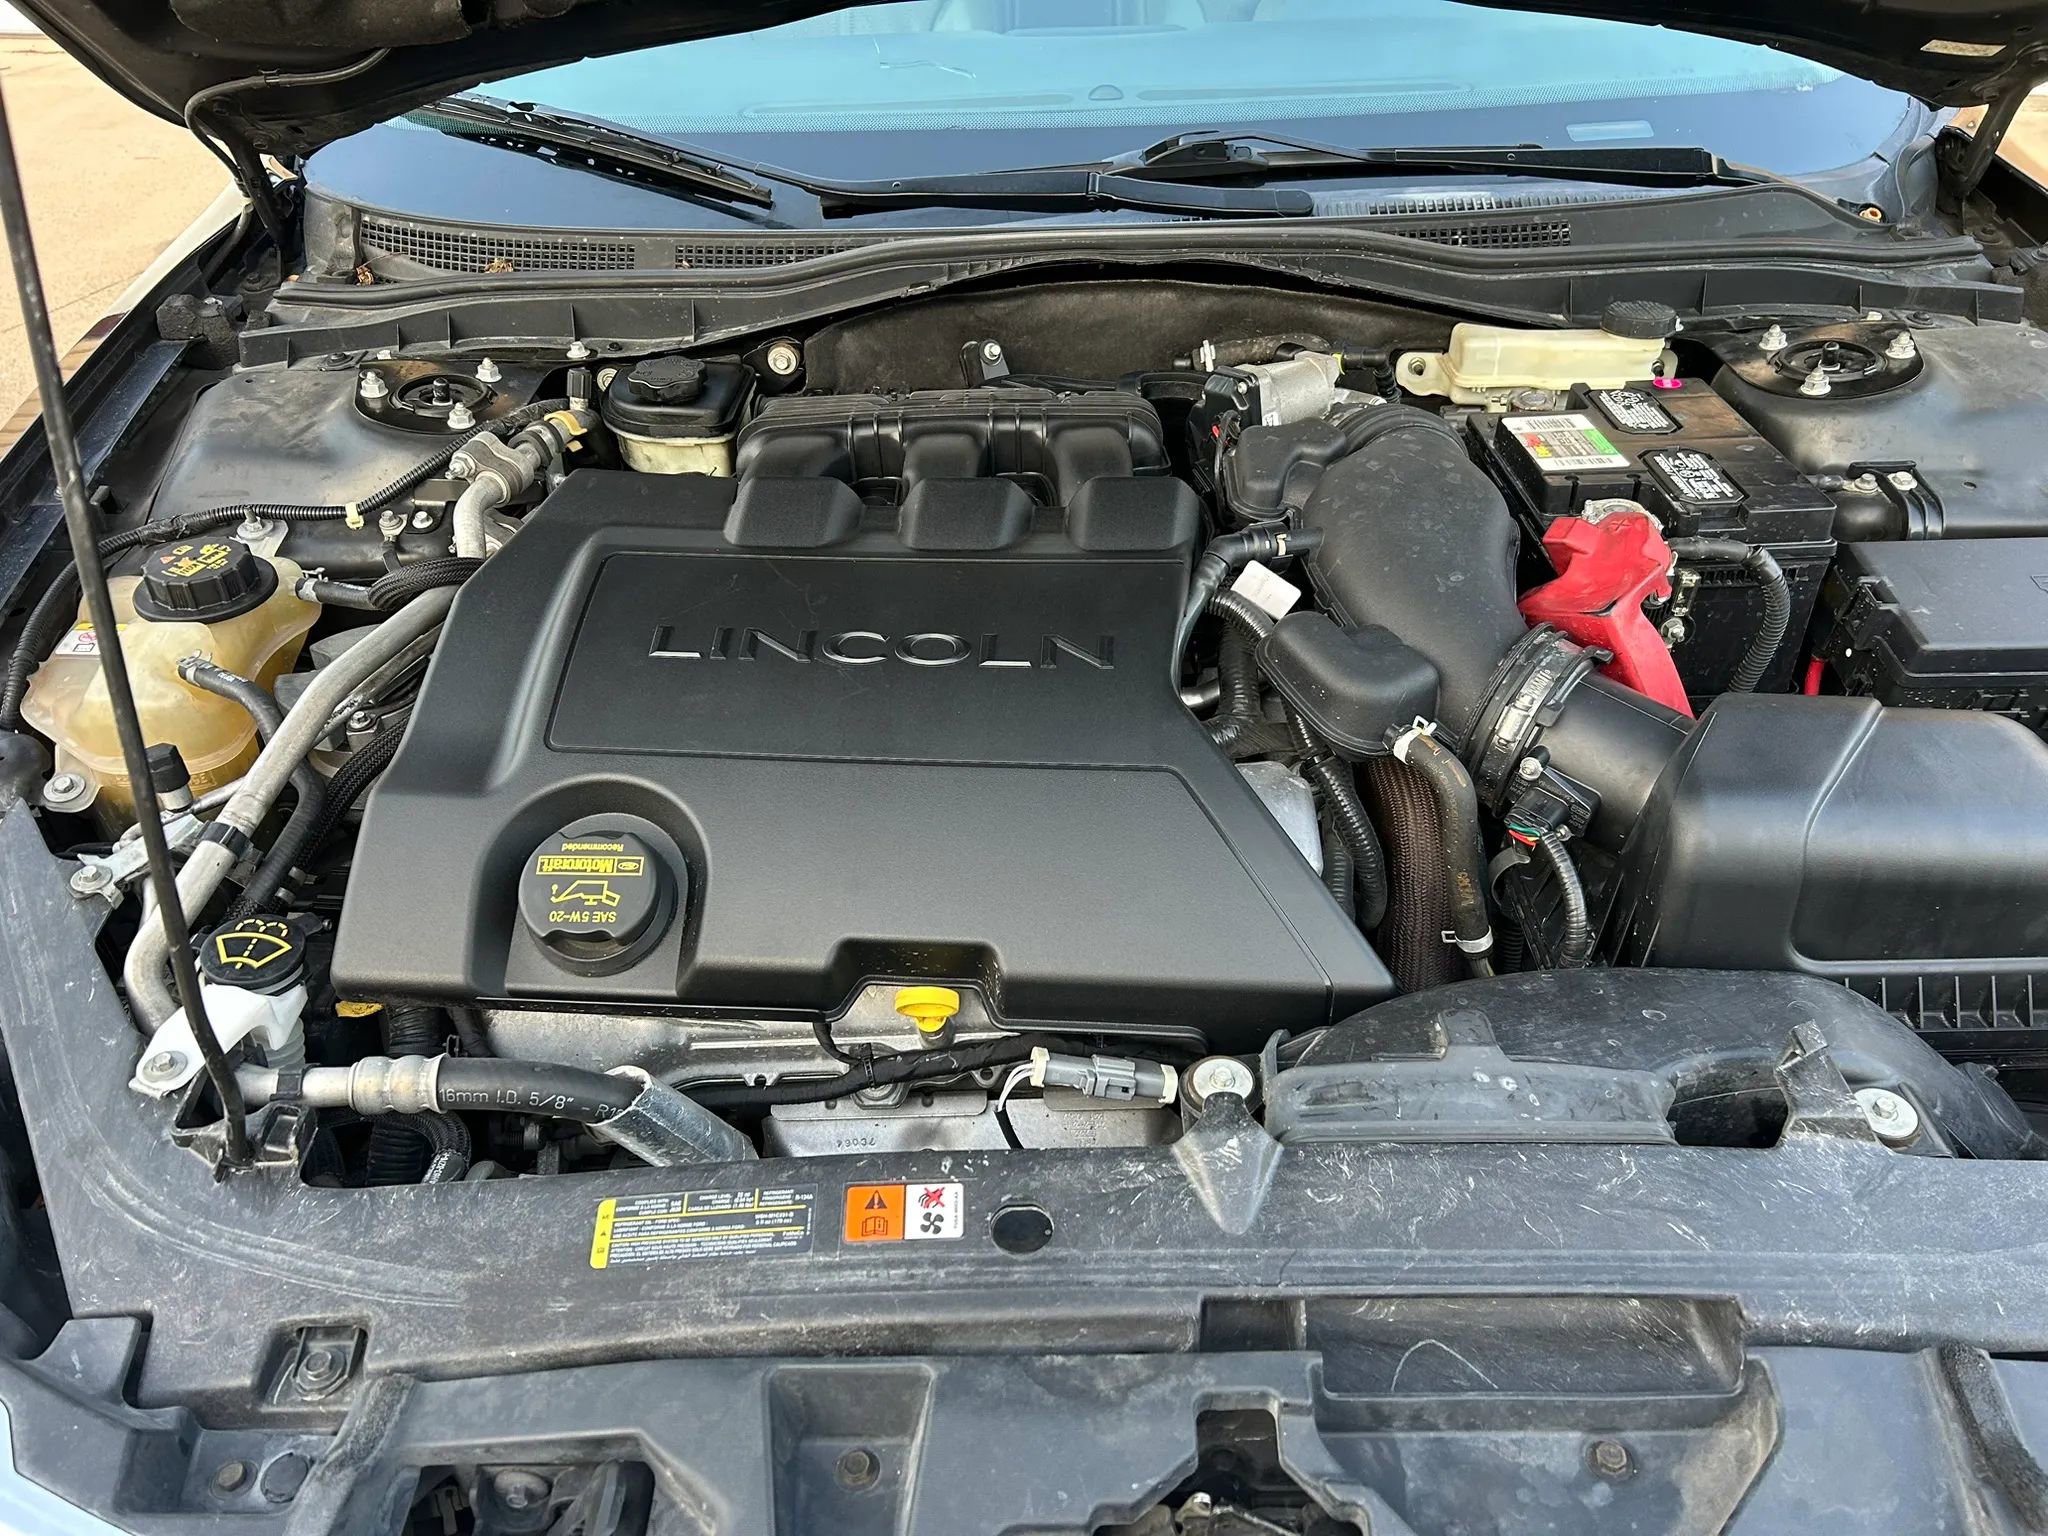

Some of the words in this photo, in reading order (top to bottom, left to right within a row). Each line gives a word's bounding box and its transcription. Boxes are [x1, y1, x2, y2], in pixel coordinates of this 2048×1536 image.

[648, 624, 1114, 670] LINCOLN
[561, 843, 624, 852] Recommended
[541, 858, 615, 873] Motorcraft
[549, 911, 590, 923] 5W-20
[592, 911, 617, 923] SAE
[439, 1088, 488, 1102] 16mm
[497, 1090, 521, 1105] I.D.
